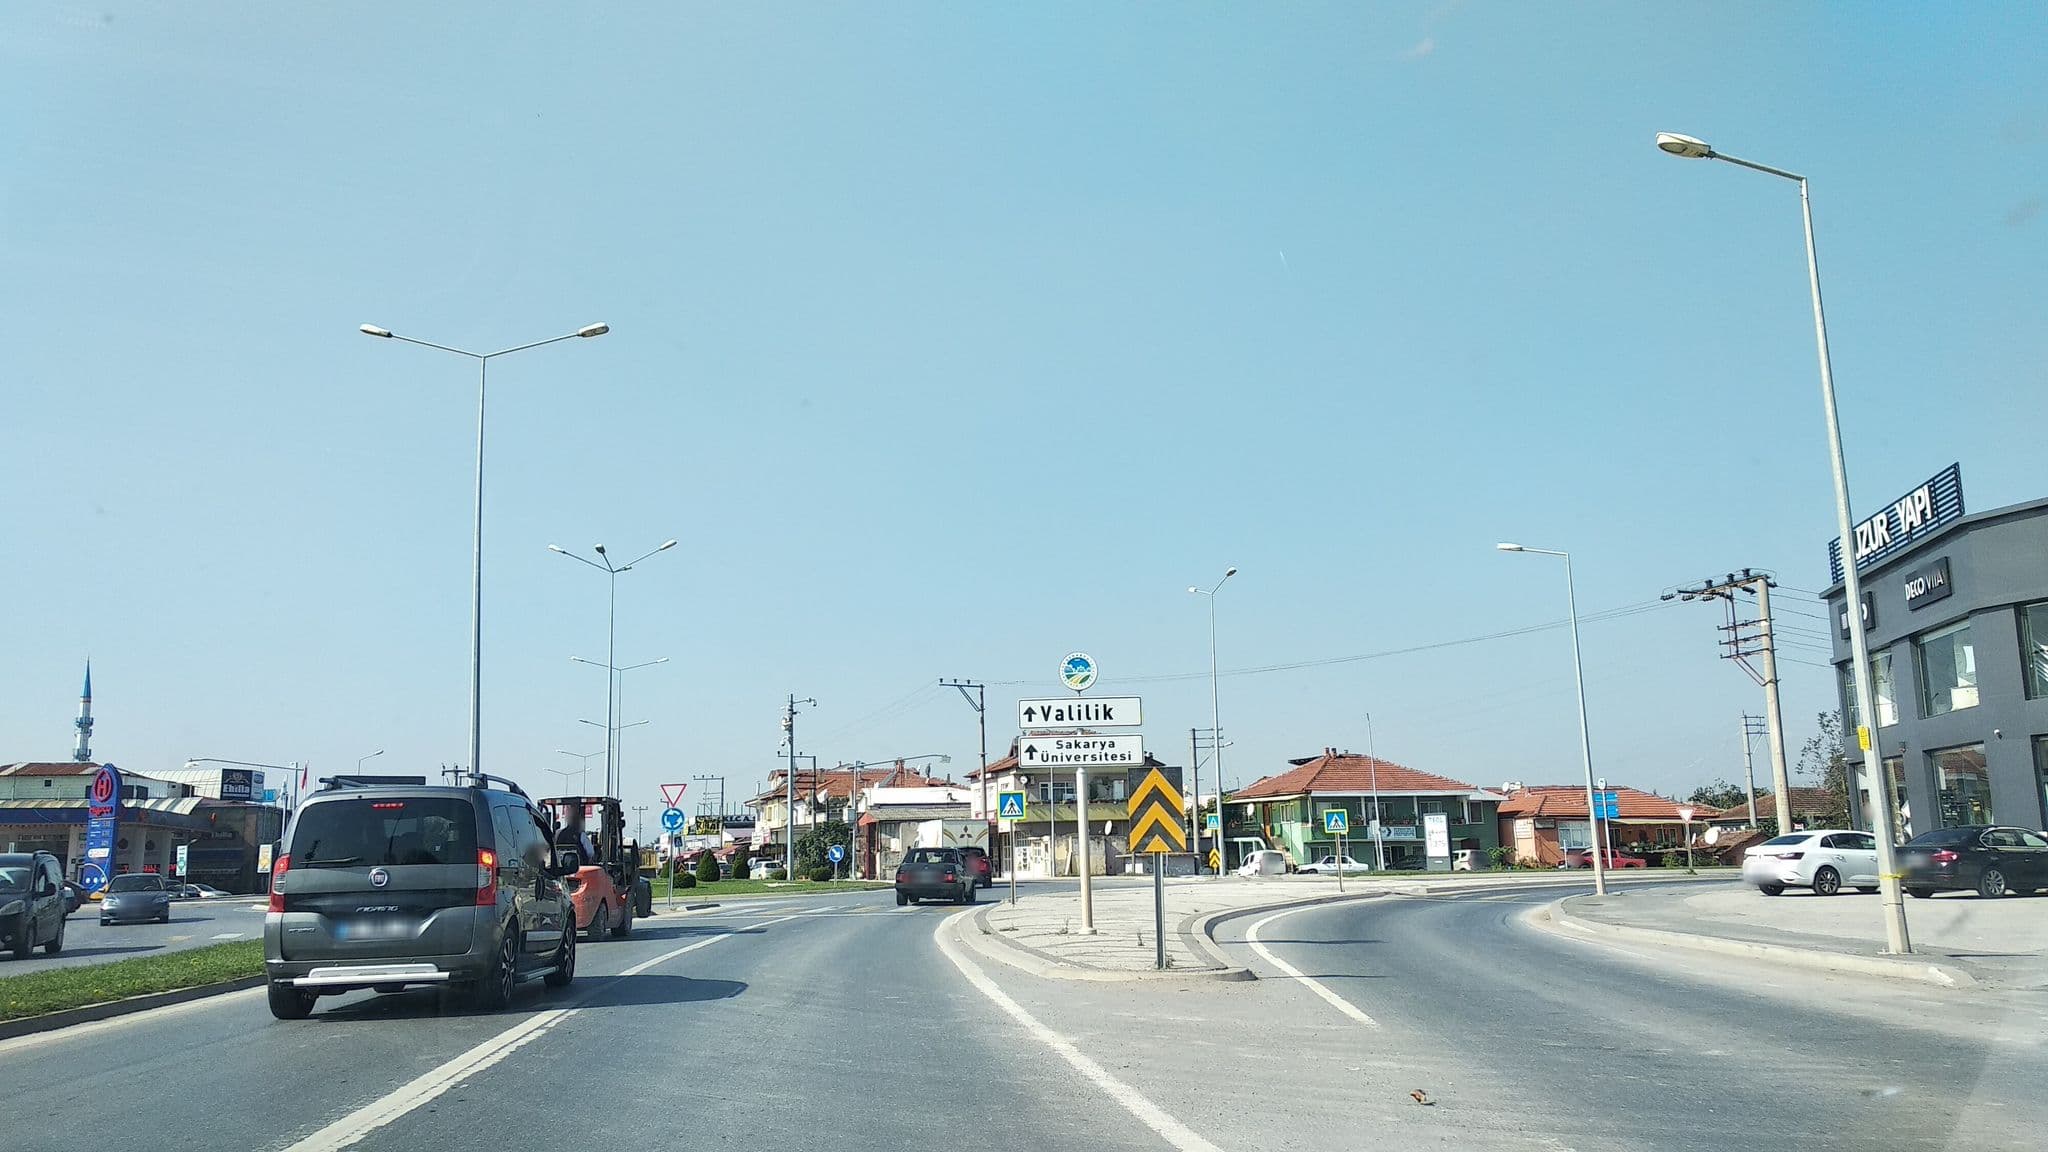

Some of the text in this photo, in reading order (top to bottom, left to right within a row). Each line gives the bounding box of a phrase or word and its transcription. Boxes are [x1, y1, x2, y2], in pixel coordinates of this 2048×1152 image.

[1894, 485, 1933, 534] YAPI
[1904, 577, 1925, 601] DECO
[1040, 703, 1114, 722] Valilik
[1056, 739, 1116, 751] Sakarya
[1040, 750, 1132, 763] Üniversitesi
